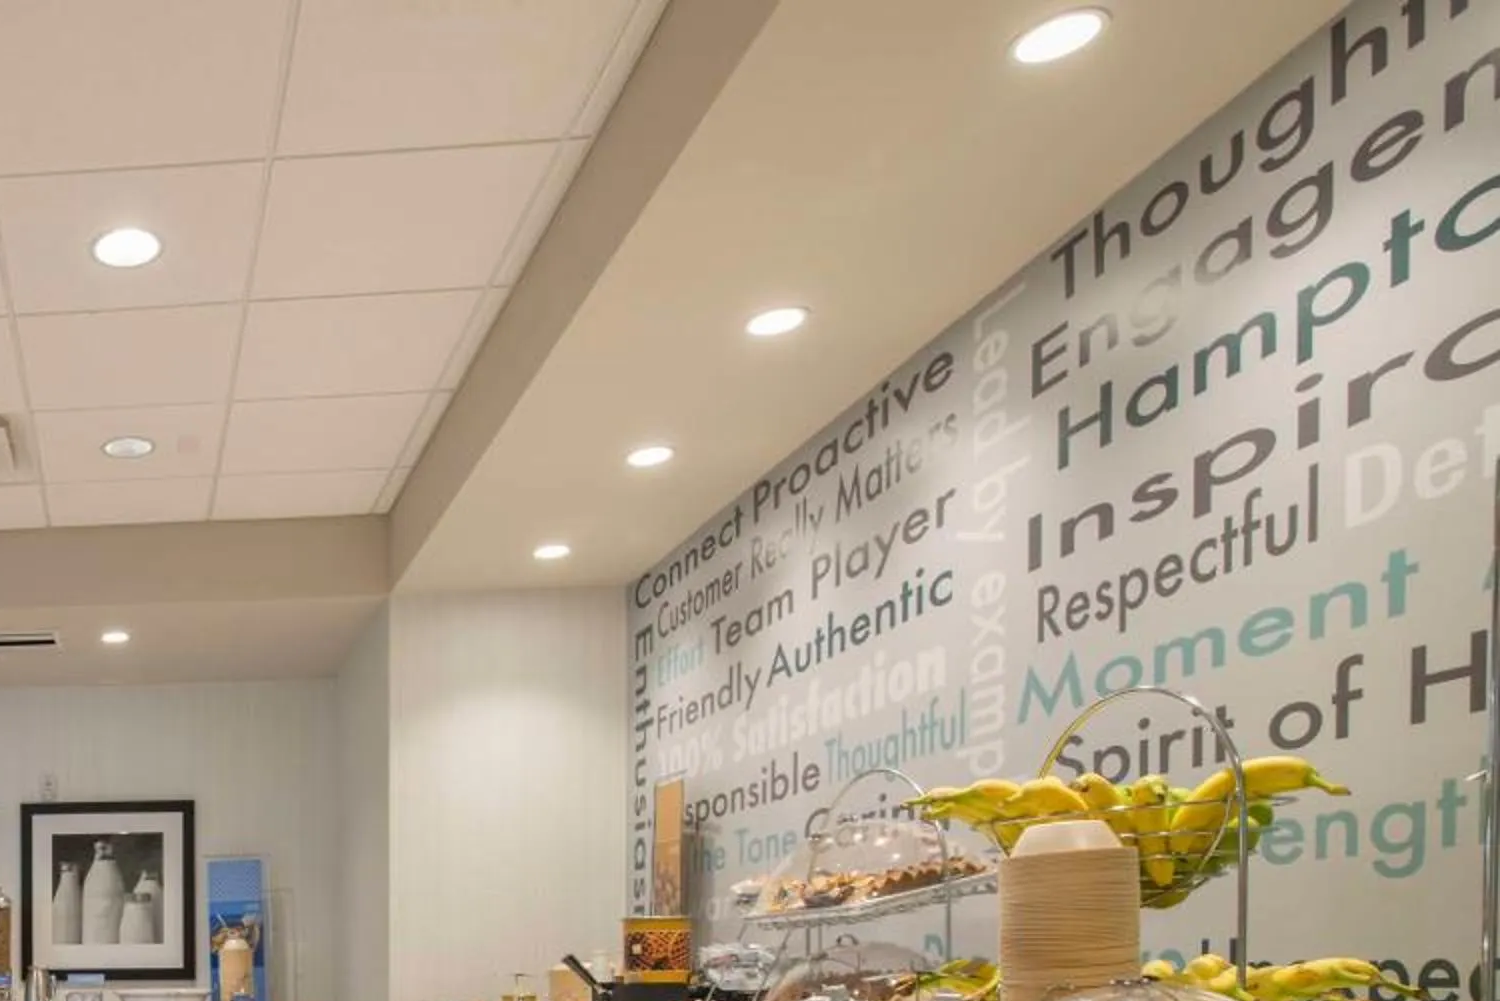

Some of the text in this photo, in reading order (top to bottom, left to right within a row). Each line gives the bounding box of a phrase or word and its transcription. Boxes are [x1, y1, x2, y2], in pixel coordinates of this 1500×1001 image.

[1051, 0, 1468, 299] Thought
[634, 352, 954, 608] Connect Proactive
[657, 413, 957, 638] Customer Really Matters
[957, 283, 1031, 778] Lead by examp
[1037, 462, 1319, 643] Respectful
[657, 569, 953, 740] Friendly Authentic
[710, 588, 794, 655] Team
[812, 489, 956, 599] Player
[1016, 547, 1419, 725] Moment
[683, 686, 967, 831] sponsible Thoughtful
[732, 645, 947, 754] Satisfaction
[1056, 704, 1234, 785] Spirit
[1269, 654, 1364, 750] of
[734, 829, 797, 871] Tone
